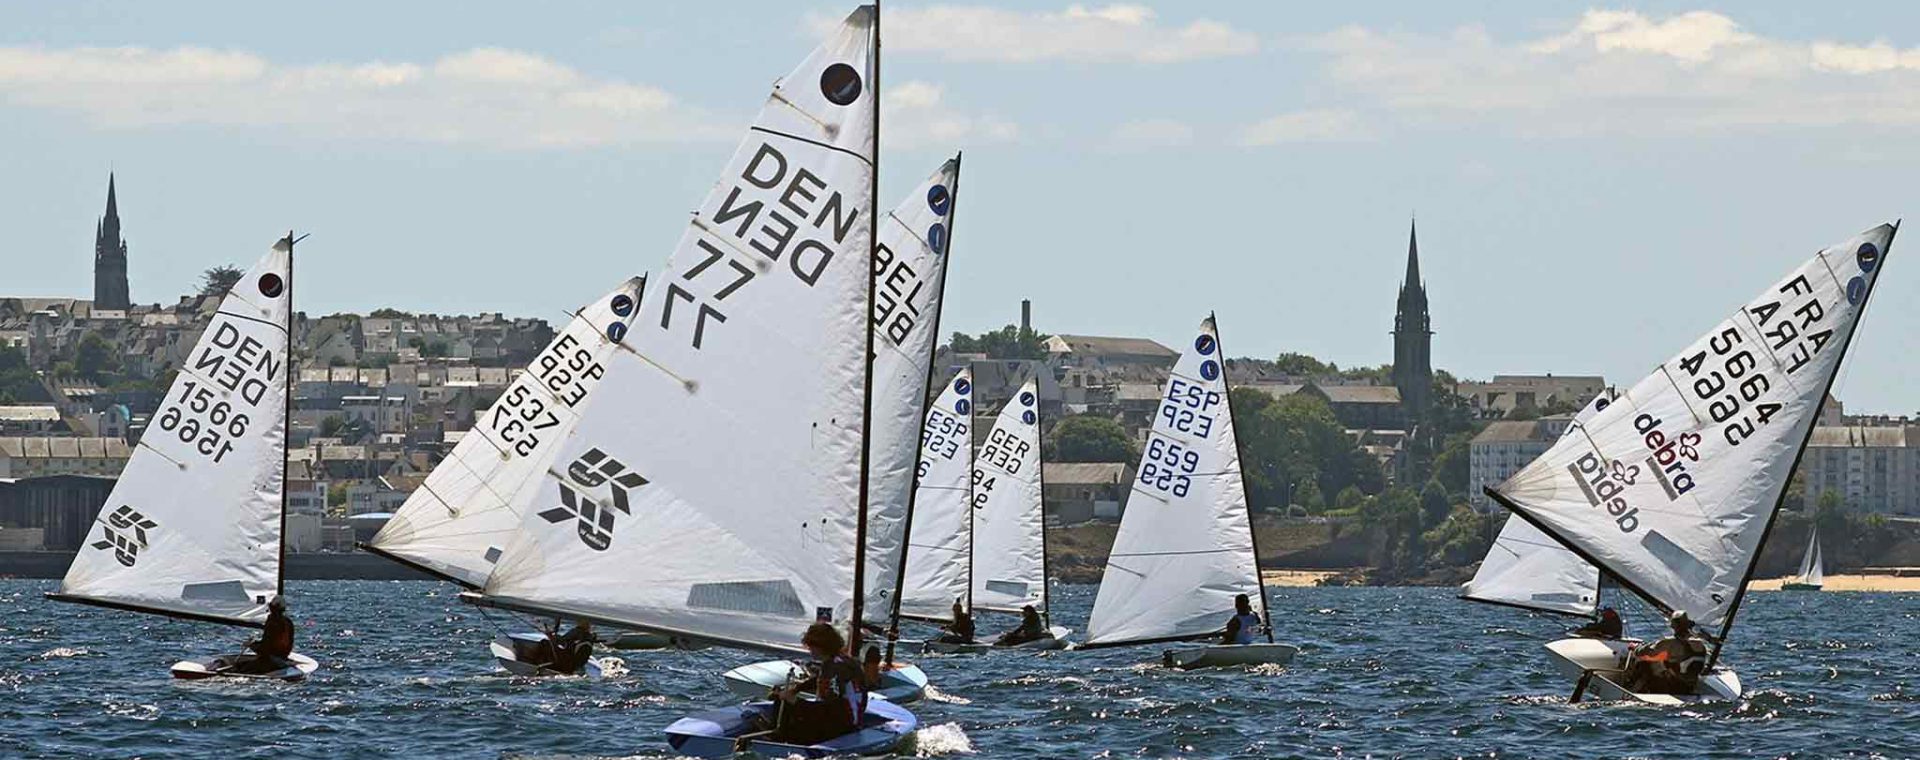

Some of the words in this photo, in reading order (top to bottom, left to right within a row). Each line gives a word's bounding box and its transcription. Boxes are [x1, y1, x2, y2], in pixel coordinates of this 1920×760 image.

[741, 142, 858, 244] DEN
[682, 239, 755, 301] 77
[875, 242, 923, 317] BEL
[1780, 274, 1833, 354] FRA
[211, 322, 280, 381] DEN
[552, 334, 604, 381] ESP
[1710, 327, 1782, 425] 5664
[178, 382, 249, 438] 1566
[506, 385, 560, 429] 537
[1168, 380, 1220, 411] ESP
[927, 411, 967, 438] ESP
[991, 428, 1030, 458] GER
[1148, 438, 1199, 473] 659
[1634, 414, 1695, 495] debra
